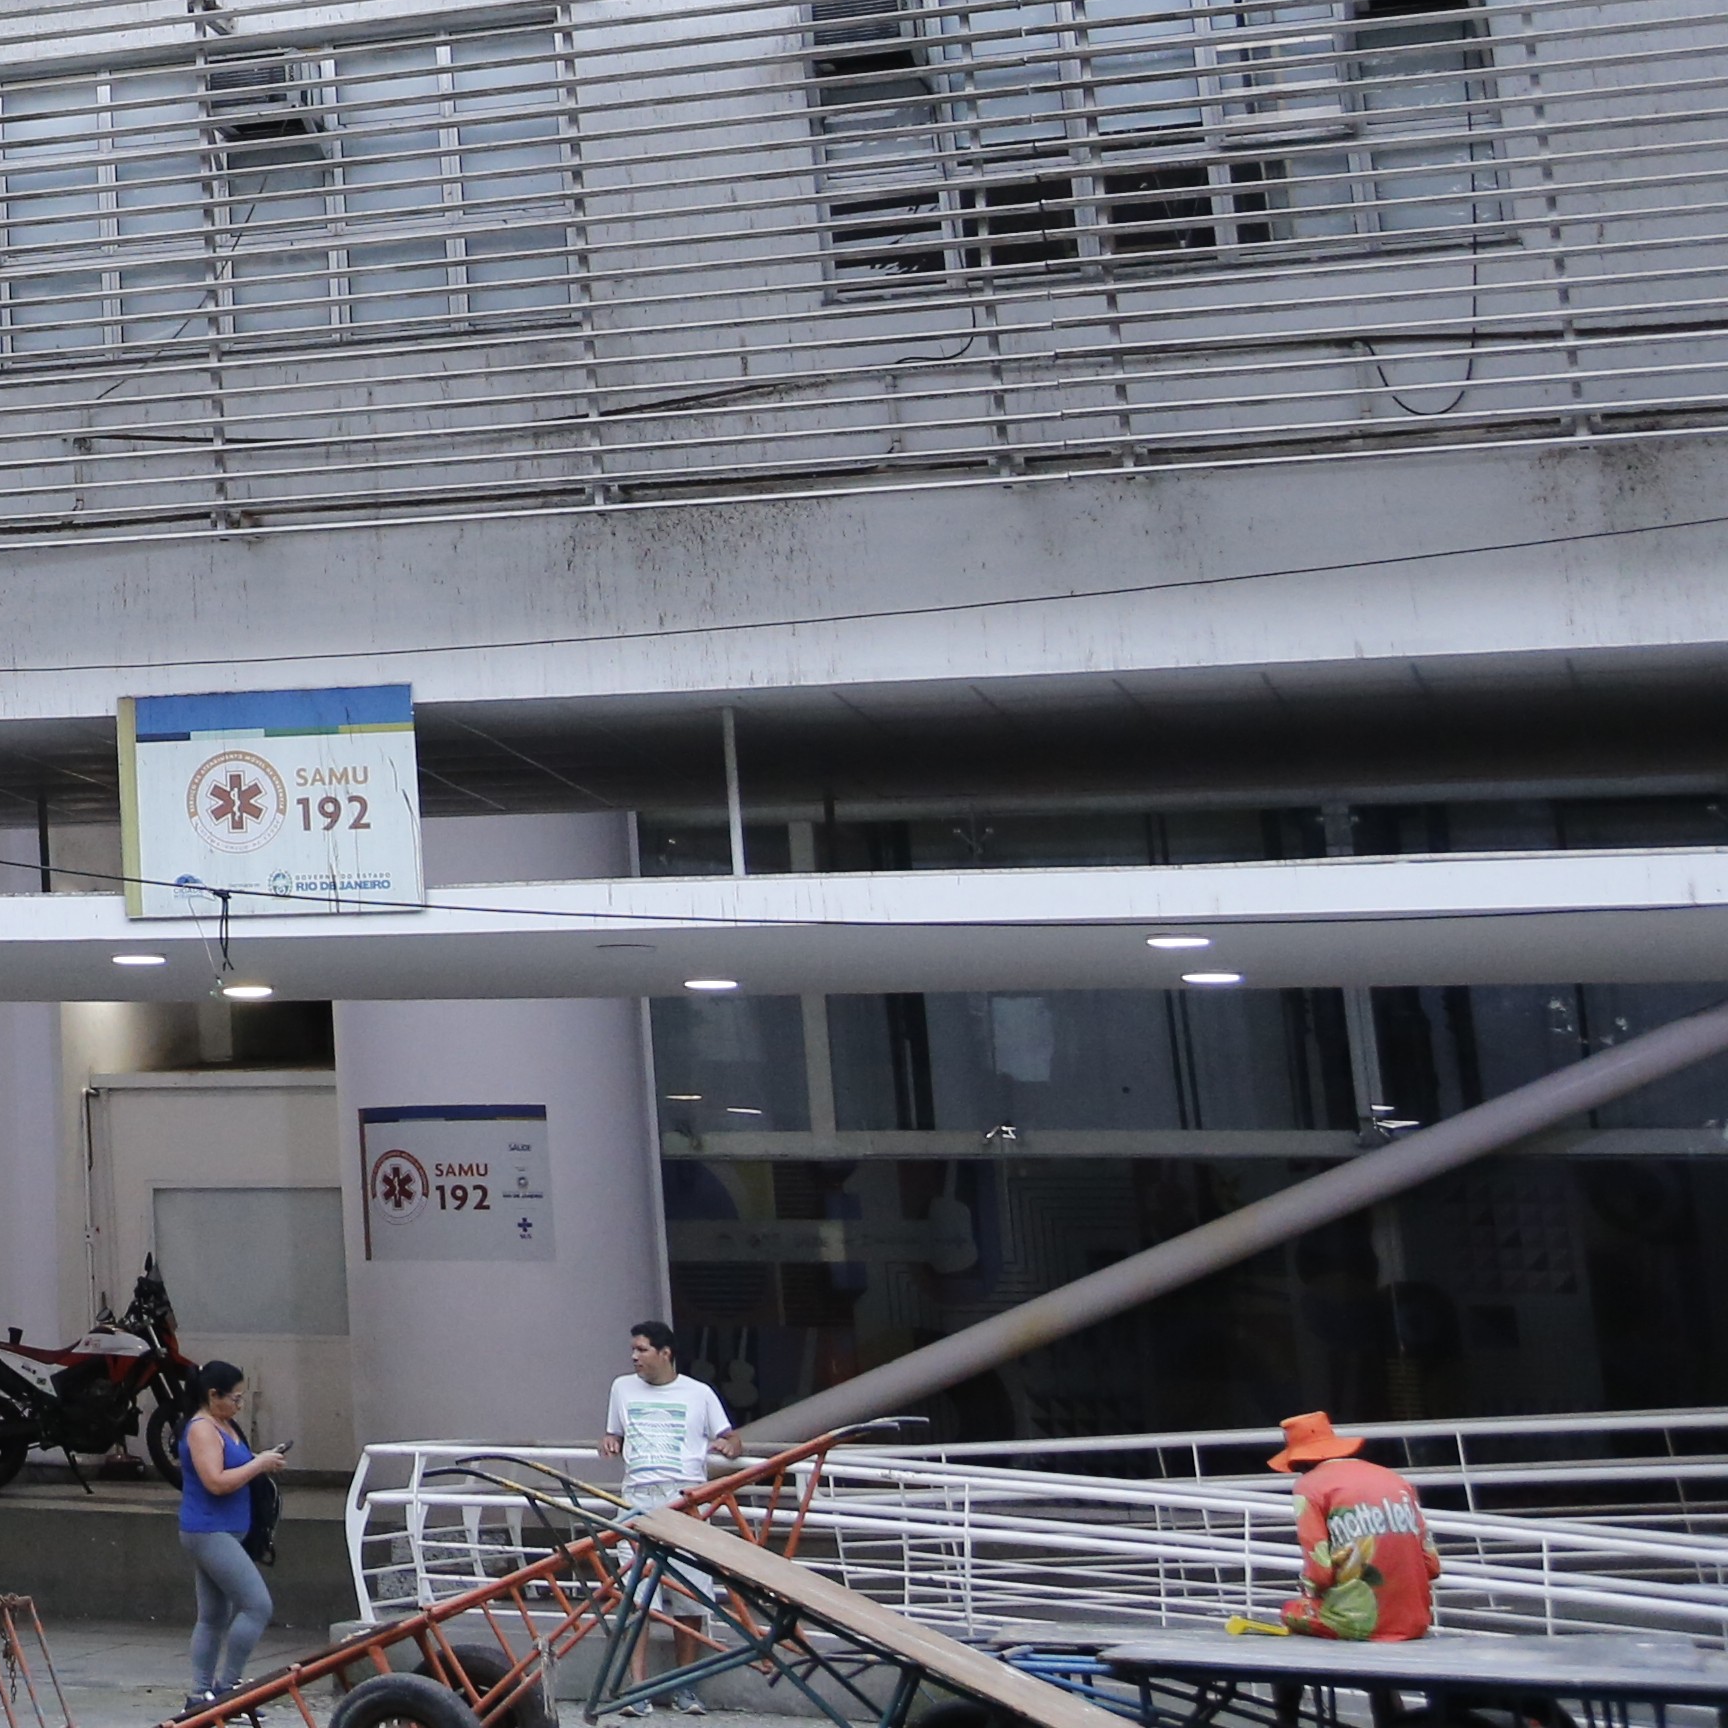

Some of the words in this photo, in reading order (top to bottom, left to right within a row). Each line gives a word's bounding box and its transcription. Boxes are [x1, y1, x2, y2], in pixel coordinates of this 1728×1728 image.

[296, 766, 369, 787] SAMU
[296, 795, 371, 831] 192
[295, 881, 318, 892] RIO
[320, 880, 336, 891] DE
[339, 879, 391, 891] JANEIRO
[435, 1163, 488, 1177] SAMU
[435, 1184, 490, 1210] 192
